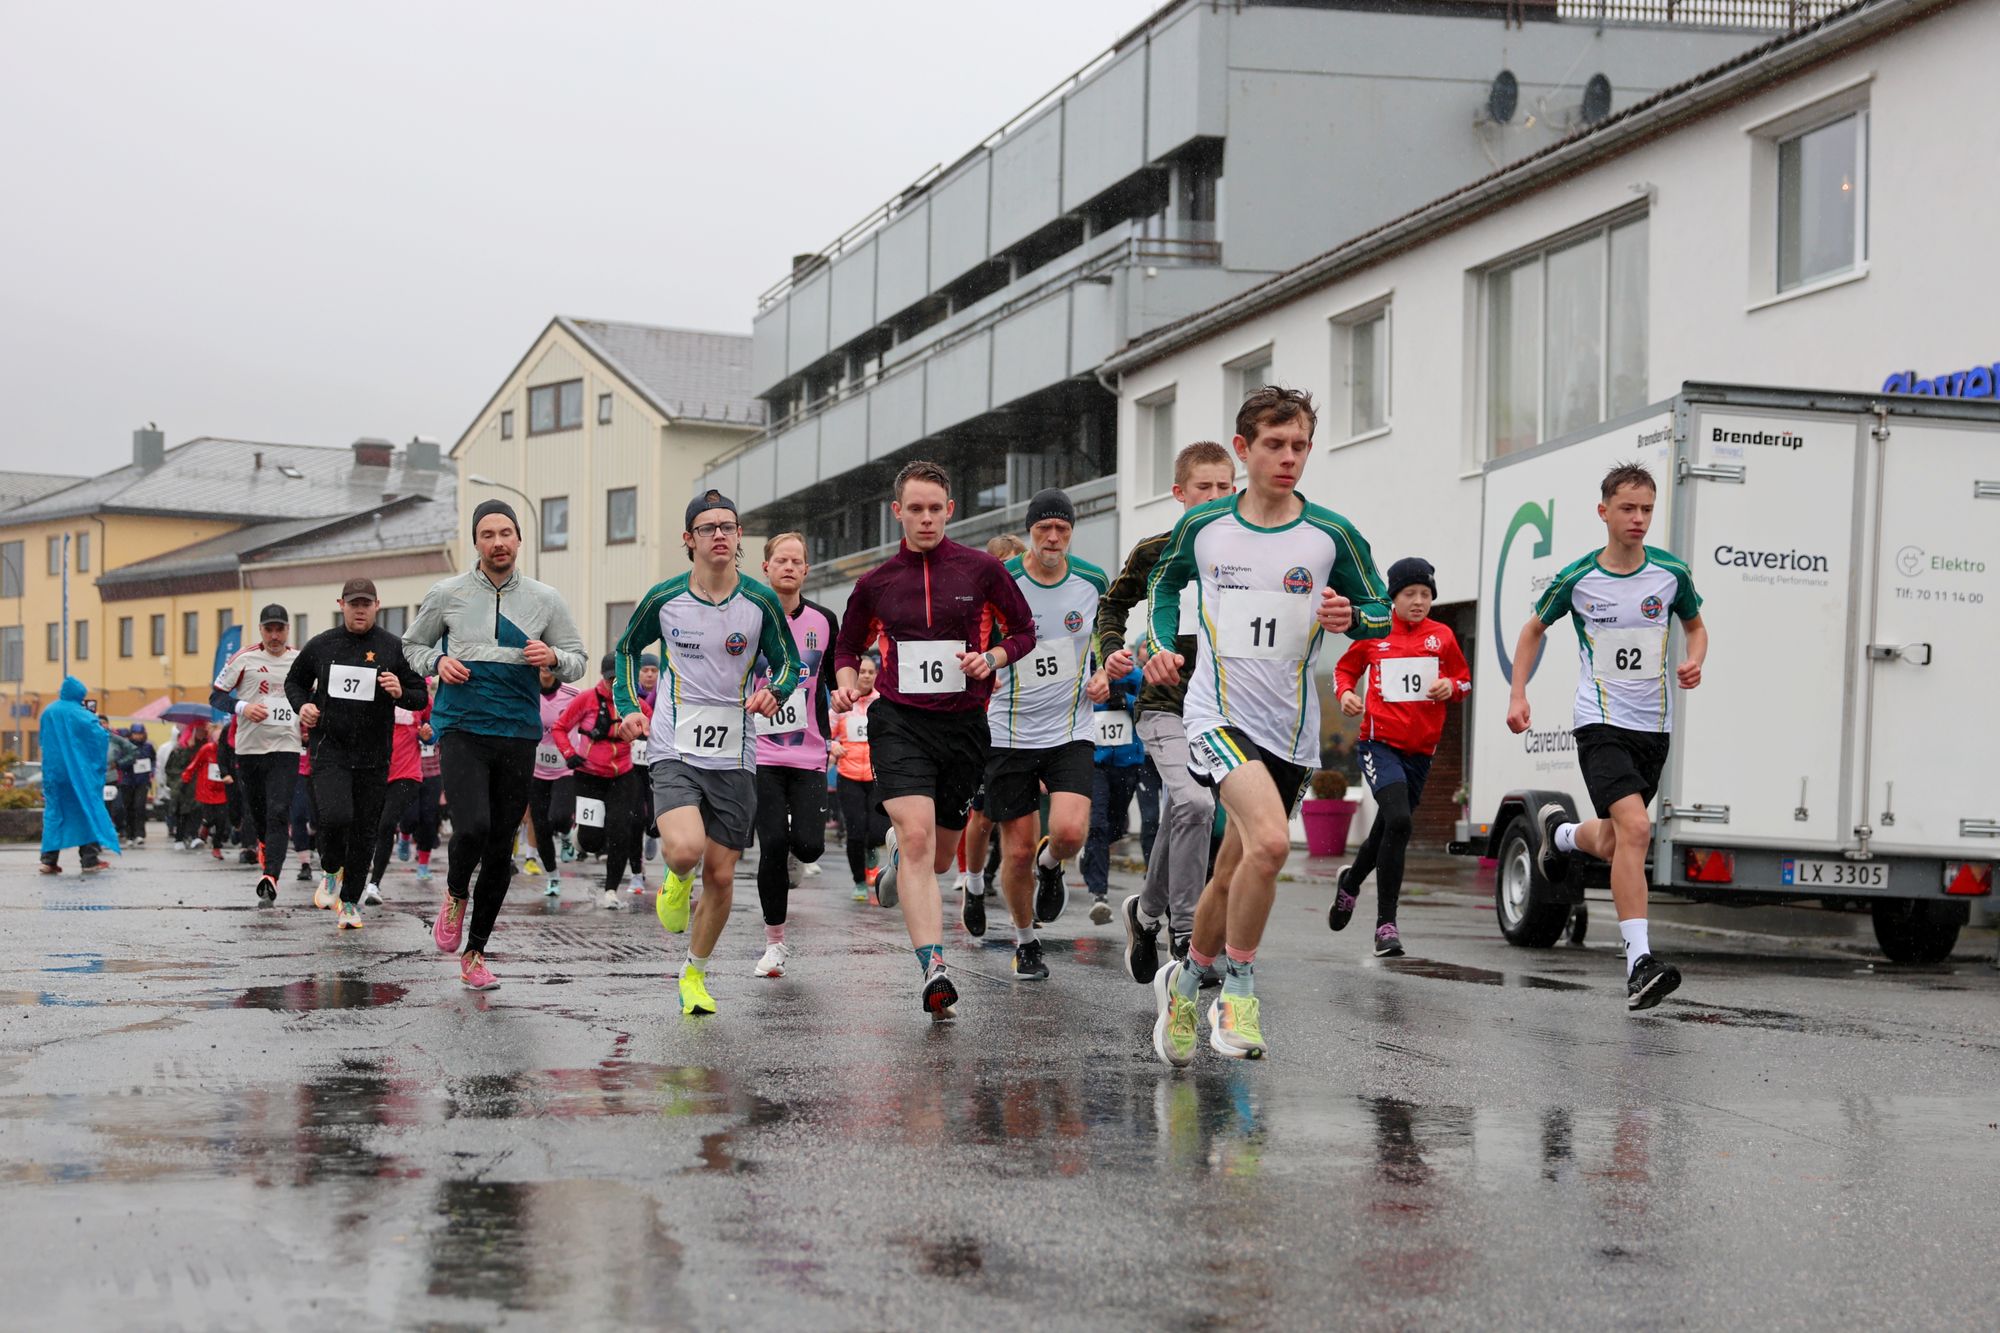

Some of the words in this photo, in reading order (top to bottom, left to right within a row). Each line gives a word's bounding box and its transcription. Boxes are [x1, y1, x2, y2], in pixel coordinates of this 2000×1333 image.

[1712, 427, 1803, 450] Brenderup
[1714, 545, 1829, 573] Caverion
[1931, 555, 1985, 573] Elektro
[1742, 573, 1775, 585] Building
[1776, 575, 1829, 586] Performance
[1896, 587, 1913, 599] Tlf:
[1917, 589, 1931, 600] 70
[1935, 590, 1948, 601] 11
[1952, 591, 1966, 602] 14
[1968, 592, 1984, 604] 00
[1250, 617, 1277, 647] 11
[675, 641, 700, 650] TRIMTEX
[1035, 656, 1058, 677] 55
[1615, 648, 1642, 670] 62
[919, 660, 944, 683] 16
[343, 678, 361, 694] 37
[1402, 674, 1422, 693] 19
[272, 707, 292, 721] 126
[693, 724, 729, 748] 127
[1100, 724, 1124, 739] 137
[1525, 724, 1576, 754] Caverion
[539, 752, 558, 764] 109
[1196, 735, 1223, 768] TRIMTEX
[582, 808, 595, 821] 61
[1800, 863, 1824, 882] LX
[1834, 864, 1883, 885] 3305
